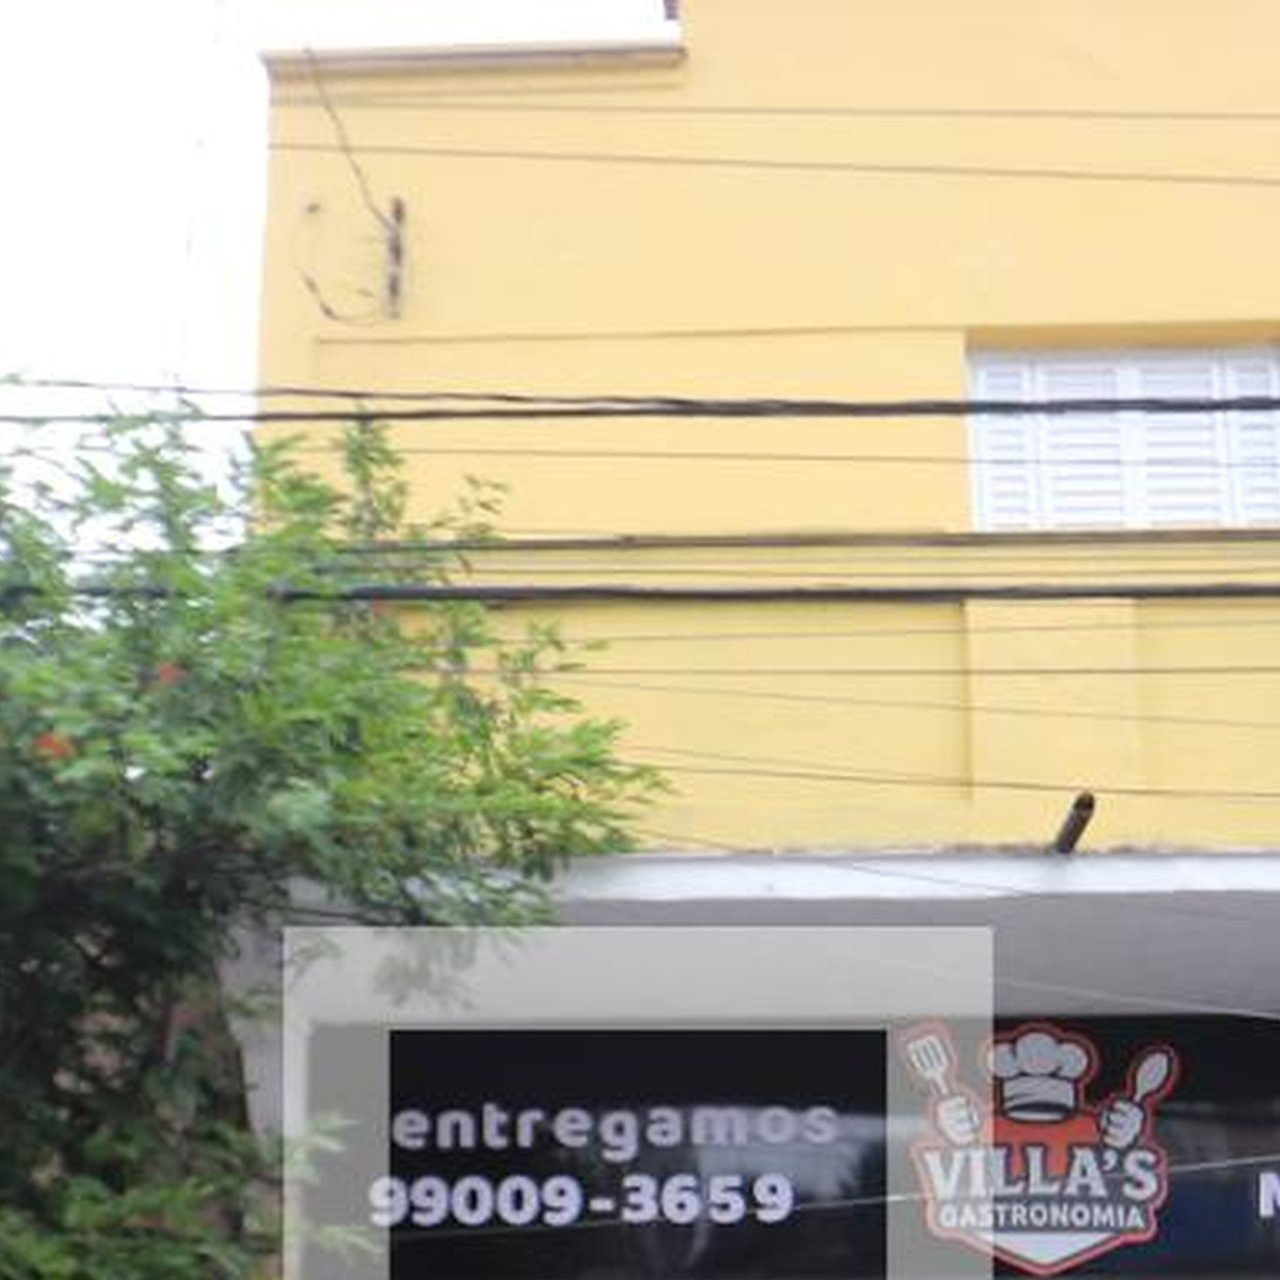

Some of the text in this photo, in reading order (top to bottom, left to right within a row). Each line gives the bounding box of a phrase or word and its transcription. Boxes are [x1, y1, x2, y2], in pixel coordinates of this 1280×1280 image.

[391, 1102, 839, 1163] entregamos
[367, 1172, 795, 1228] 99009-3659
[924, 1145, 1159, 1201] VILLA'S
[938, 1203, 1146, 1229] GASTRONOMIA
